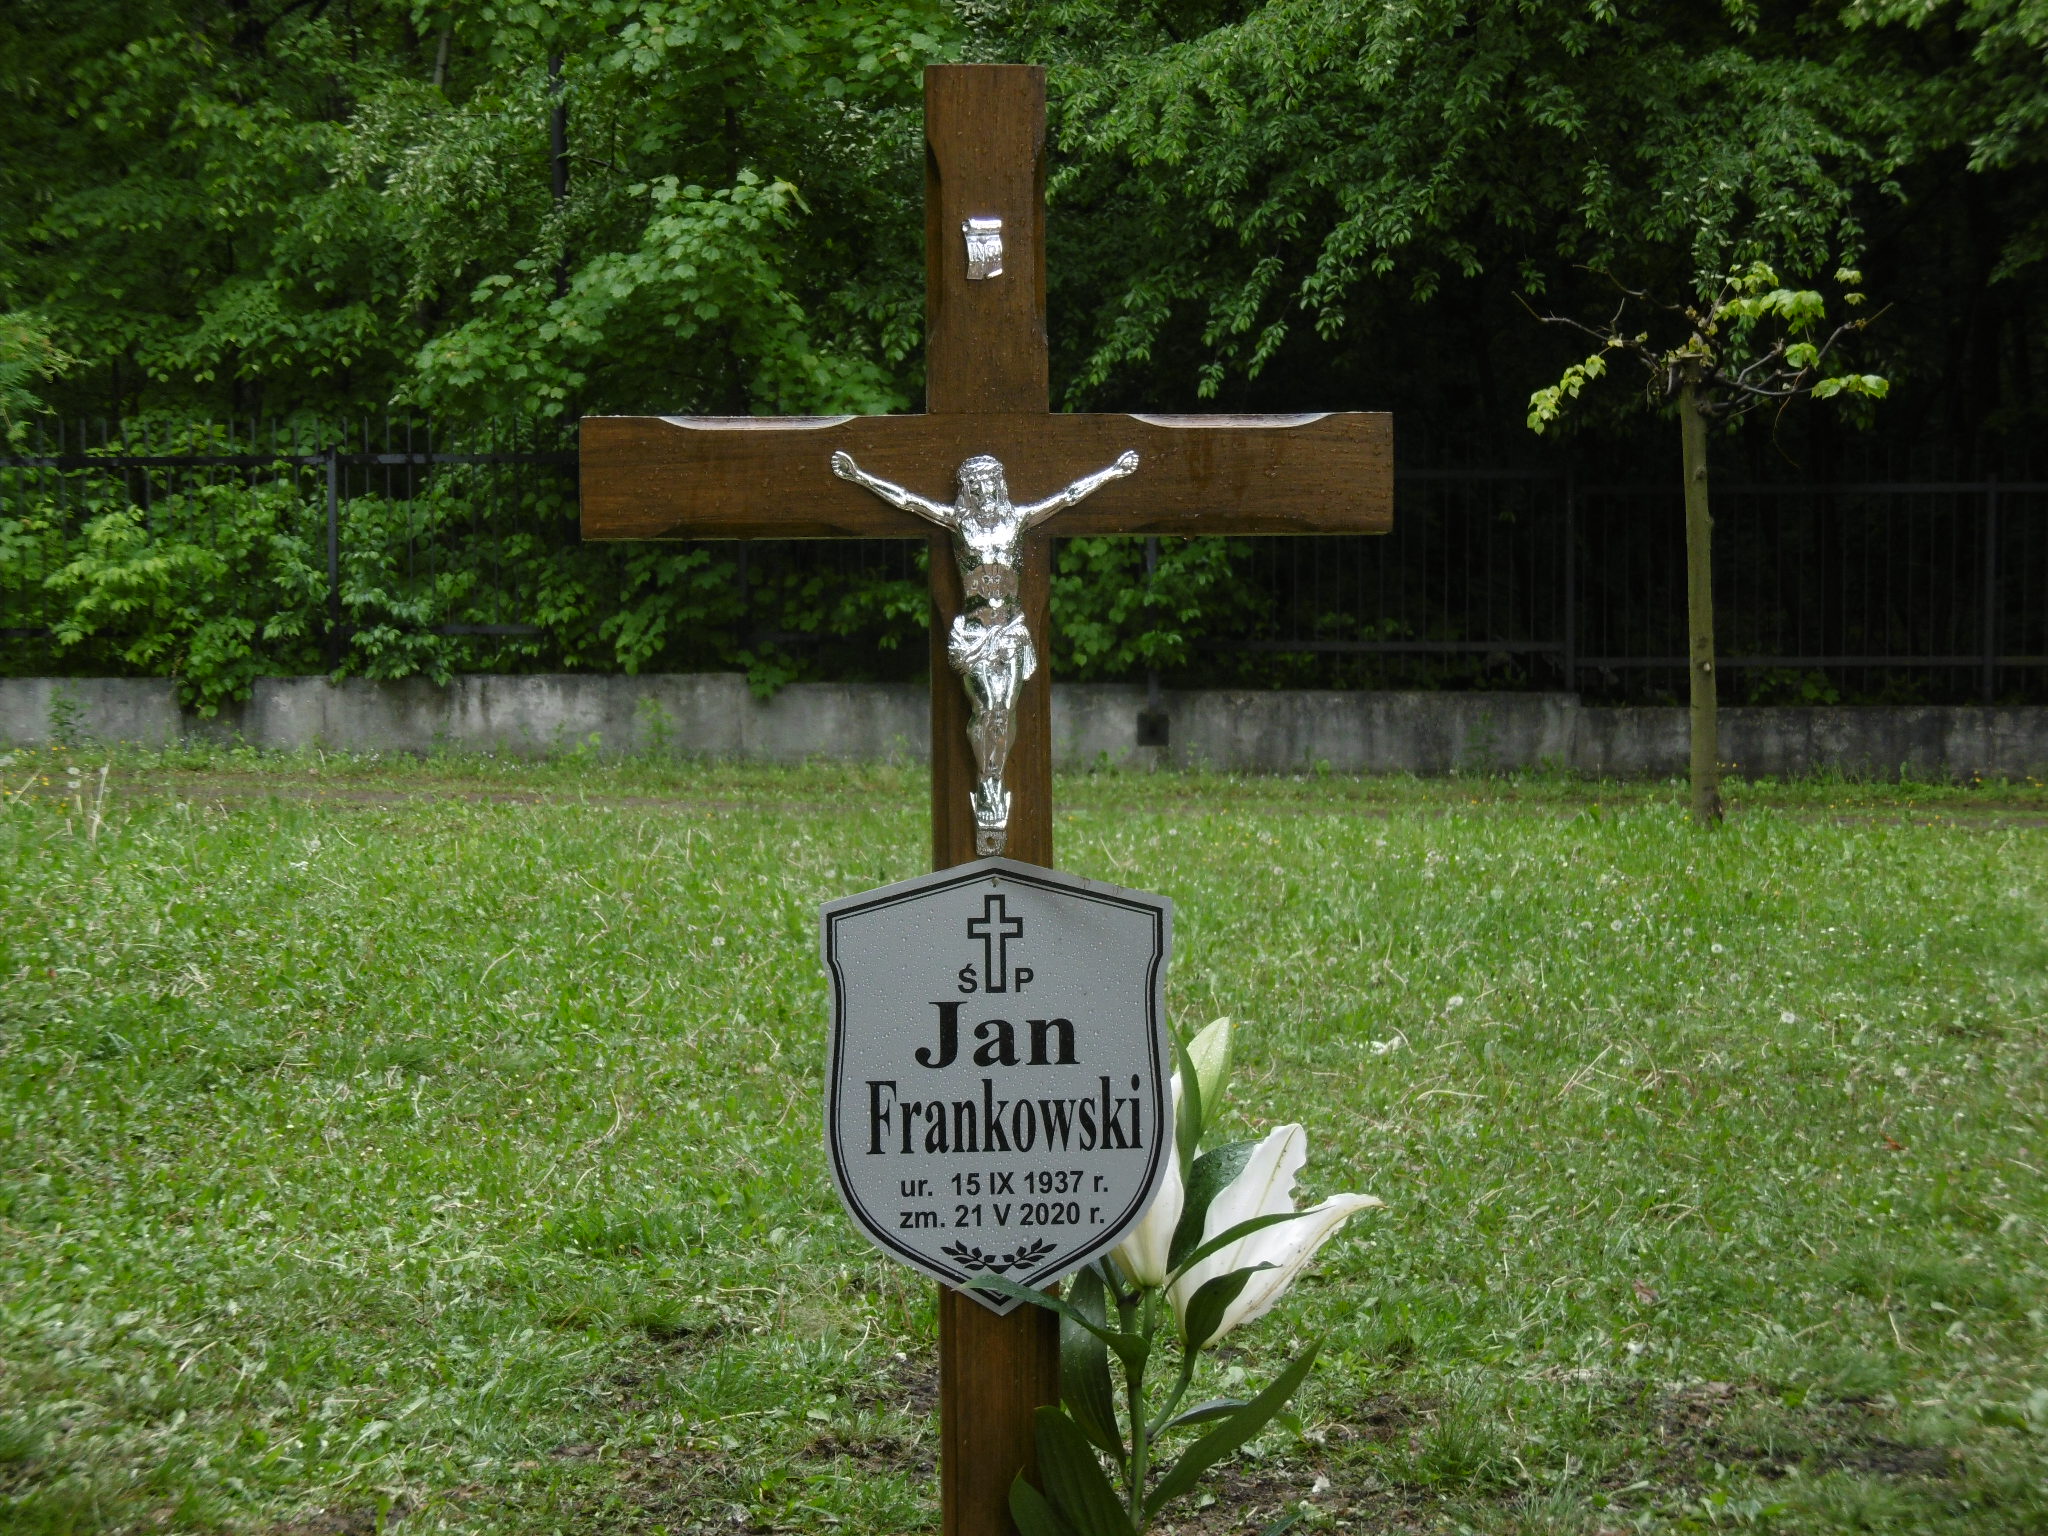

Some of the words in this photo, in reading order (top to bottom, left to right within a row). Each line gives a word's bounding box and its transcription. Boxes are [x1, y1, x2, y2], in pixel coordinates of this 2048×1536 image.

[957, 963, 978, 994] Ś
[1014, 967, 1035, 993] P
[914, 1001, 1081, 1069] Jan
[864, 1073, 1144, 1156] Frankowski
[900, 1179, 933, 1198] ur.
[951, 1172, 981, 1196] 15
[989, 1171, 1016, 1196] IX
[1023, 1170, 1084, 1195] 1937
[1093, 1175, 1109, 1193] r.
[899, 1210, 946, 1229] zm.
[954, 1203, 982, 1228] 21
[992, 1203, 1012, 1227] V
[1019, 1201, 1081, 1226] 2020
[1089, 1206, 1105, 1224] r.
